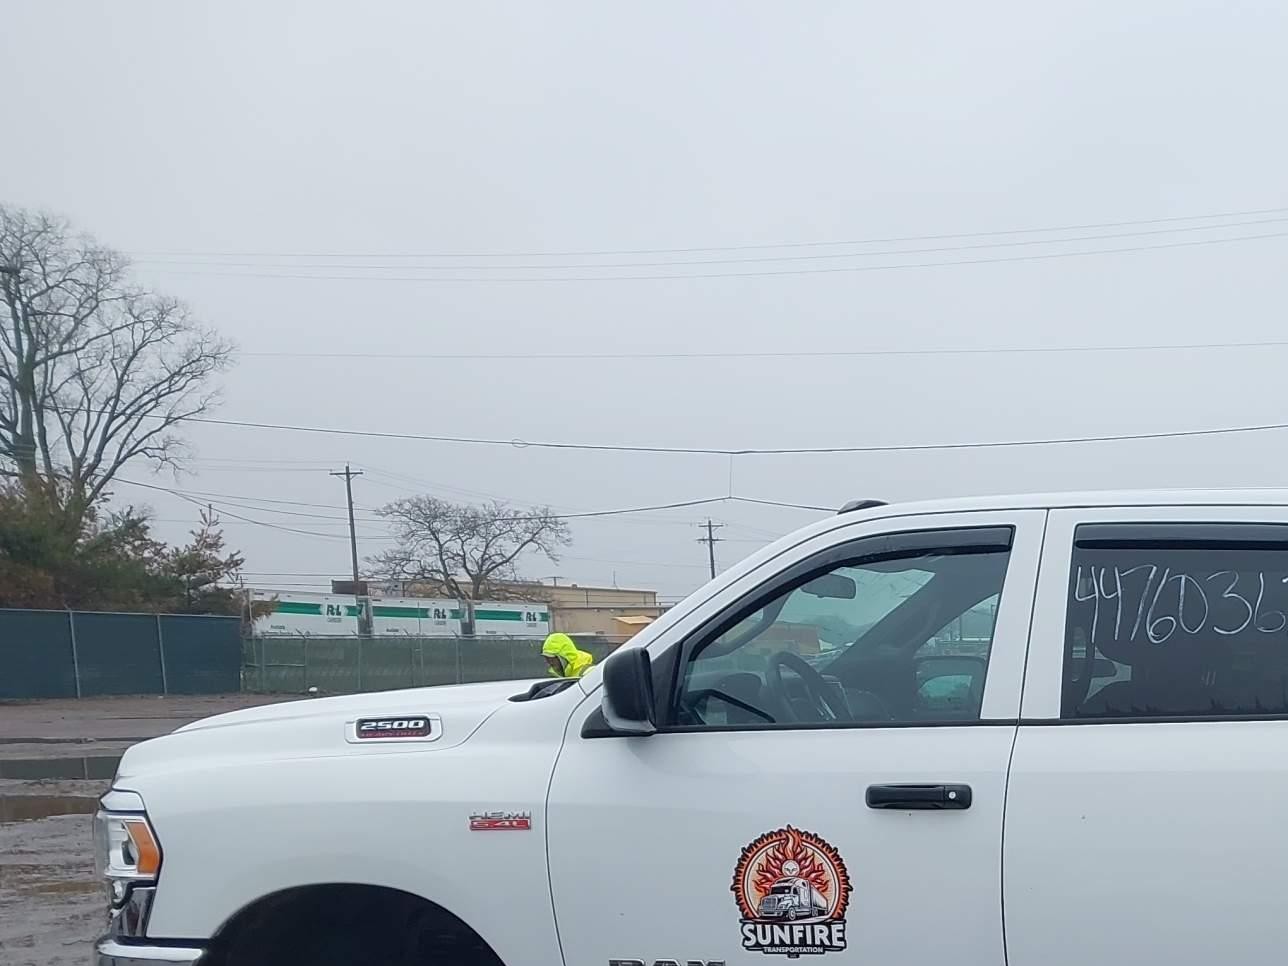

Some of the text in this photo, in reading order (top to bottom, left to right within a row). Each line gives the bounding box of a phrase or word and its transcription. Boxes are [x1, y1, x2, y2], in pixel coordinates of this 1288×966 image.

[360, 720, 425, 731] 2500
[742, 923, 846, 948] SUNFIRE
[764, 946, 823, 954] TRANSPORTATION
